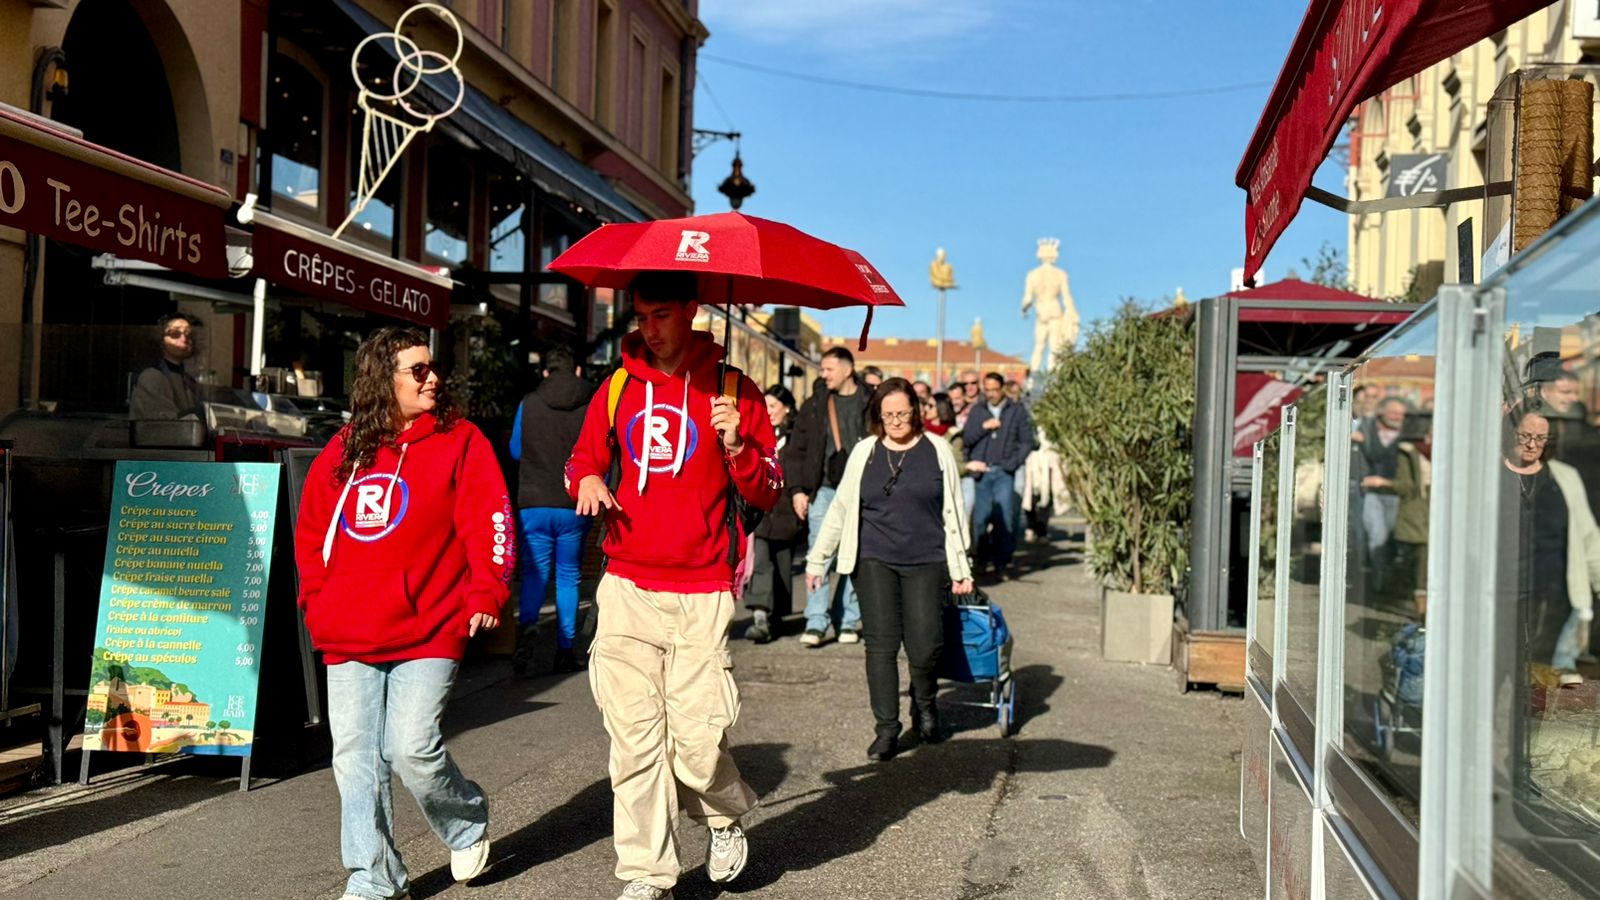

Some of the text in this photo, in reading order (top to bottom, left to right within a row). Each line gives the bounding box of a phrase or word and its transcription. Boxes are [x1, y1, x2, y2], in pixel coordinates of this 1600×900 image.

[46, 177, 201, 264] Tee-Shirts
[676, 252, 710, 260] RIVIERA
[283, 249, 356, 294] CRÊPES
[370, 277, 431, 316] GELATO
[126, 471, 215, 502] Crêpes
[120, 505, 269, 520] Crêpe au sucre 4,00
[119, 518, 268, 533] Crêpe au sucre beurre 5,00
[117, 531, 266, 547] Crêpe au sucre citron 5,00
[116, 544, 265, 560] Crêpe au nutella 5,00
[114, 557, 264, 572] Crêpe banane nutella 7,00
[113, 571, 262, 586] Crêpe fraise nutella 7,00
[111, 584, 260, 599] Crêpe caramel beurre salé 5,00
[109, 597, 140, 609] Crêpe
[176, 600, 190, 610] de
[191, 601, 232, 612] marron
[241, 603, 259, 613] 5,00
[108, 610, 139, 623] Crêpe
[149, 612, 160, 621] la
[160, 613, 209, 624] confiture
[239, 616, 258, 626] 5,00
[106, 624, 134, 634] fraise
[148, 626, 183, 637] abricot
[104, 637, 136, 650] Crêpe
[145, 638, 156, 649] la
[157, 639, 202, 650] cannelle
[236, 643, 255, 654] 4,00
[103, 650, 254, 667] Crêpe au spéculos 5,00
